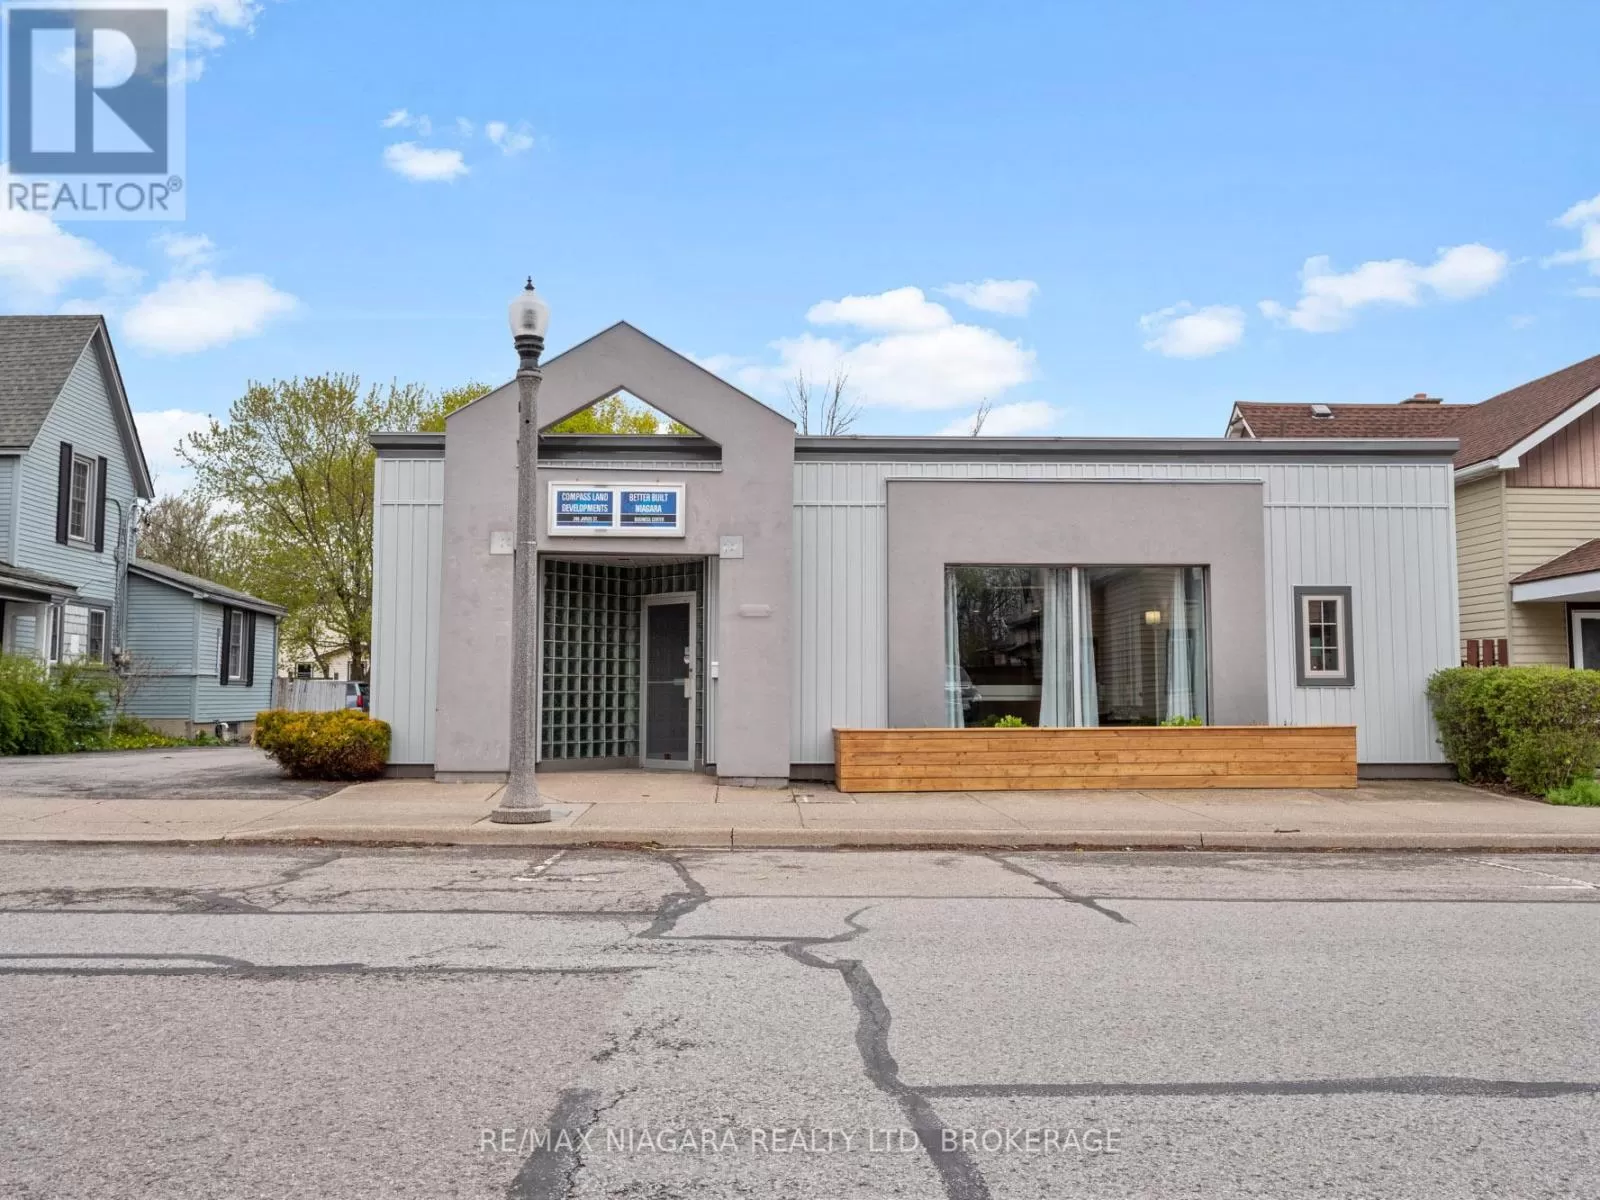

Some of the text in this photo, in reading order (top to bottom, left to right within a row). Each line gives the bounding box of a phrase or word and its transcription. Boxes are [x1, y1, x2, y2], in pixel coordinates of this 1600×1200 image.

[561, 493, 609, 502] COMPASS LAND
[629, 493, 668, 502] BETTER BUILT
[561, 503, 609, 513] DEVELOPMENTS
[635, 504, 662, 513] NIAGARA
